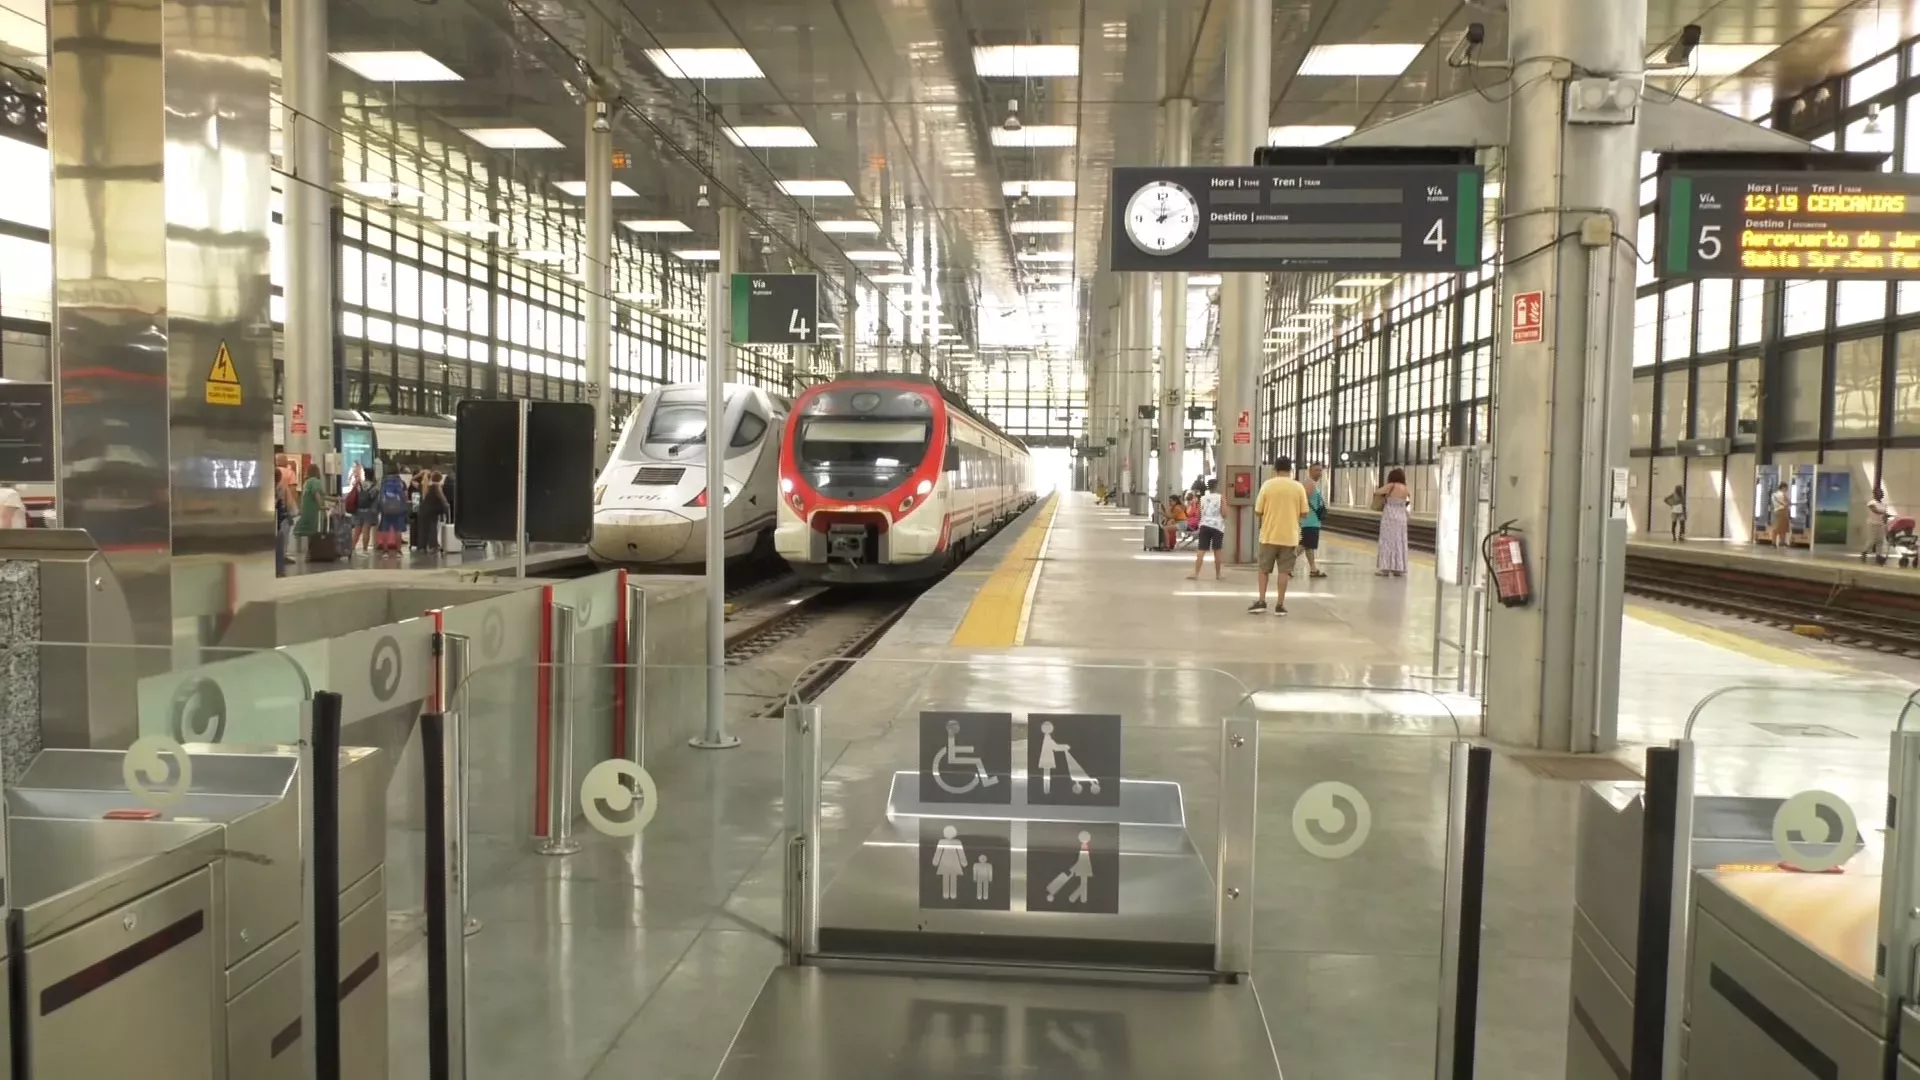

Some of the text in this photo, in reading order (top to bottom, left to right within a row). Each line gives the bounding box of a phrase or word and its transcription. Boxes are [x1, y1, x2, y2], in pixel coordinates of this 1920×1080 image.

[1211, 177, 1234, 187] Hora
[1273, 177, 1295, 187] Tren
[1747, 183, 1772, 193] Hora
[1812, 184, 1835, 193] Tren
[1744, 194, 1798, 212] 12:19
[1210, 212, 1248, 221] Destino
[1745, 218, 1784, 228] Destino
[1423, 218, 1447, 252] 4
[1742, 230, 1849, 248] Aeropuerto
[1858, 230, 1881, 248] de
[1698, 225, 1721, 260] 5
[752, 279, 766, 289] Vía
[789, 308, 811, 341] 4
